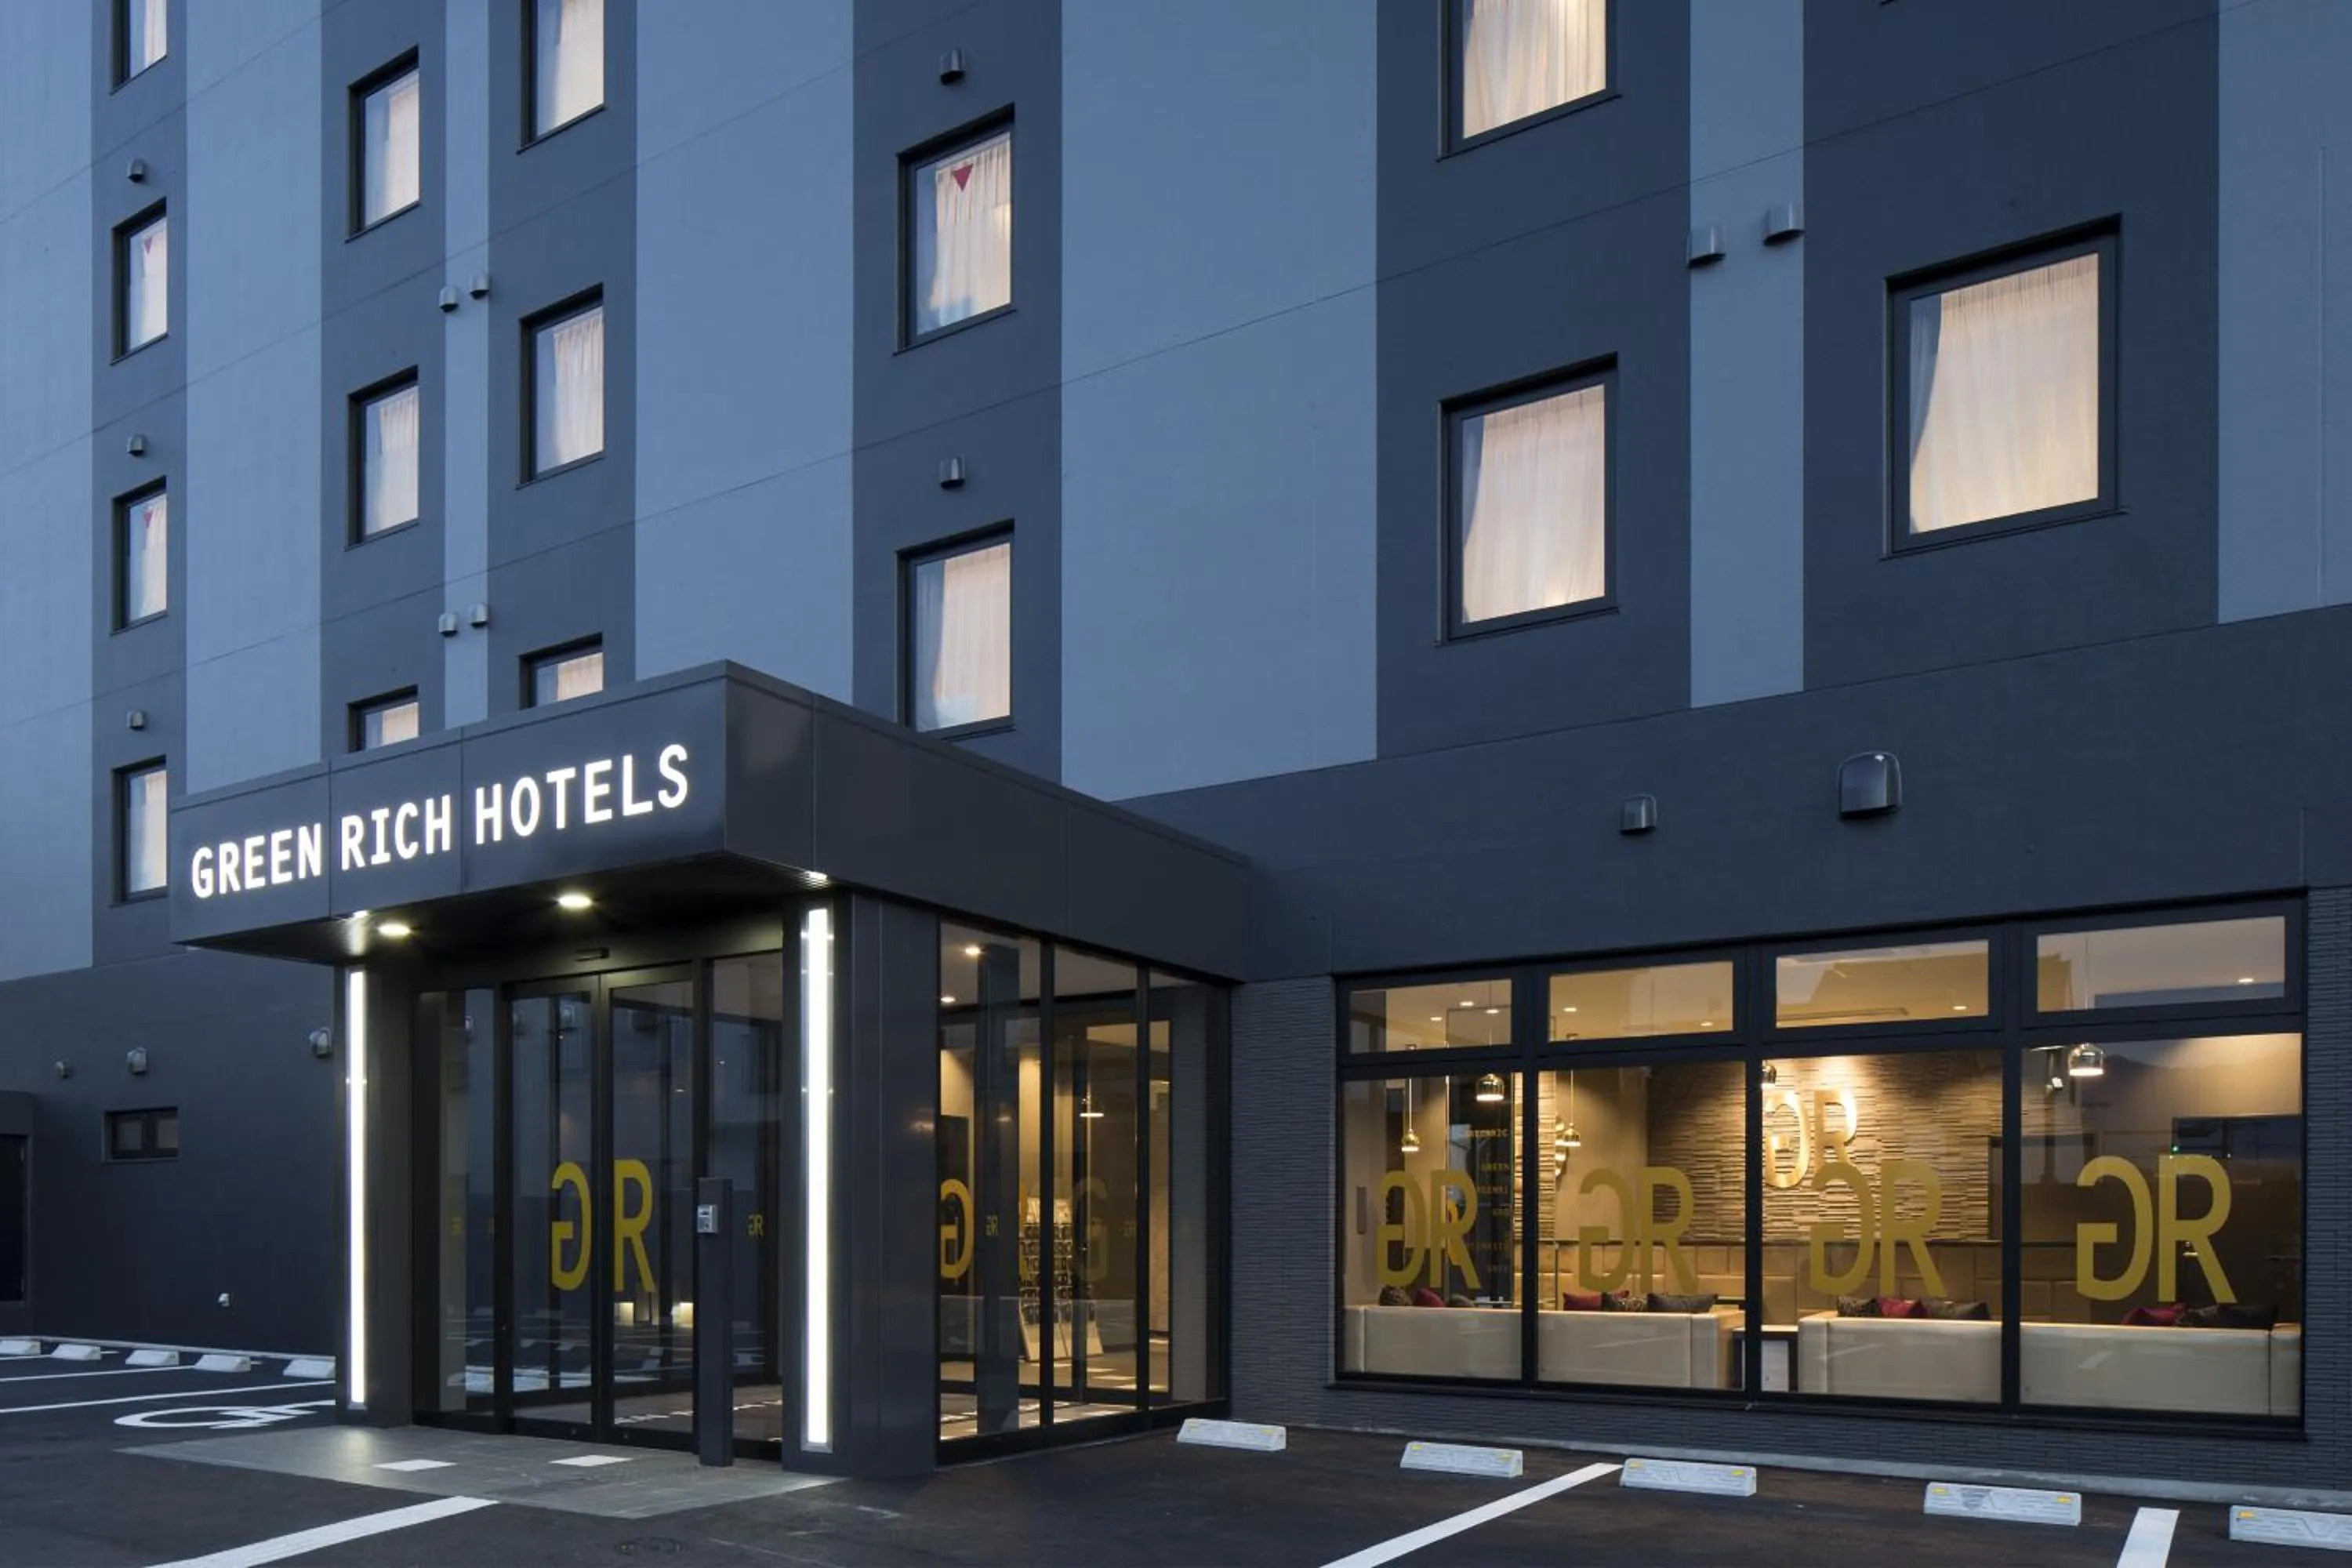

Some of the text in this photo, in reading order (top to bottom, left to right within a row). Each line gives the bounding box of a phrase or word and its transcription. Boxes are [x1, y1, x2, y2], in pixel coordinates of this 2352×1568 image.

[191, 744, 688, 898] GREEN RICH HOTELS
